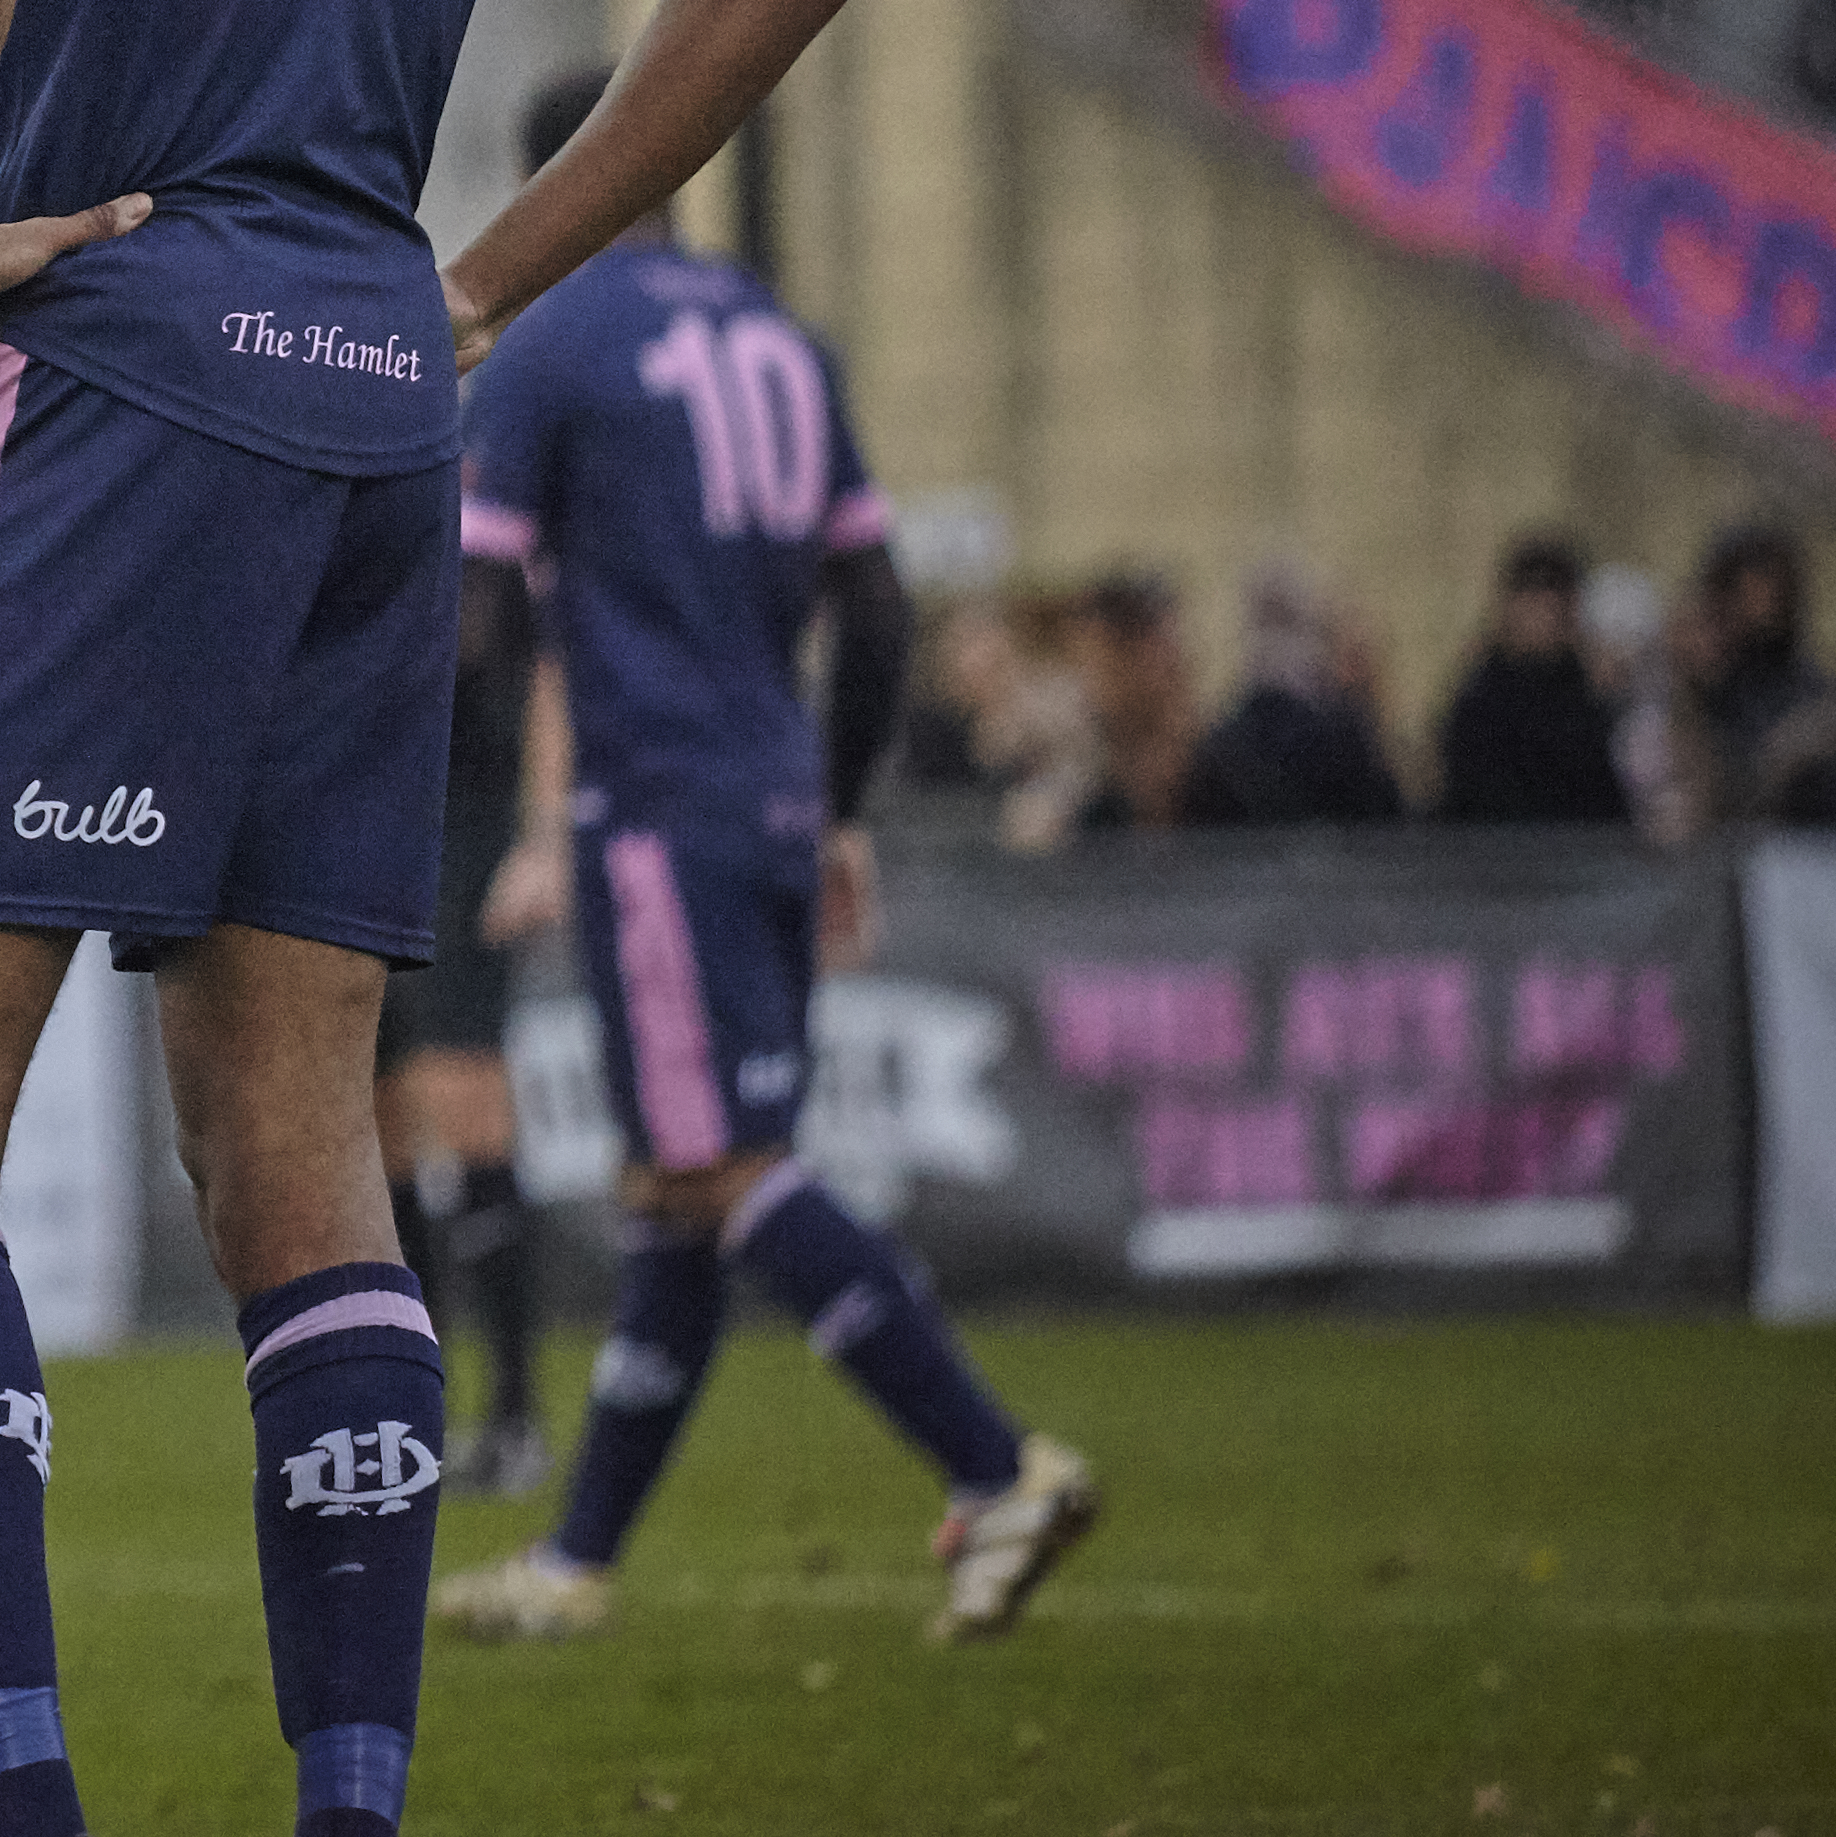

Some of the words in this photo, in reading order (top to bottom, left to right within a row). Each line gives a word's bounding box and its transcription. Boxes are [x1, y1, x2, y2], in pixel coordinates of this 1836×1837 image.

[221, 311, 293, 358] The
[302, 325, 422, 383] Hamlet
[638, 312, 827, 540] 10
[13, 779, 166, 847] bulb
